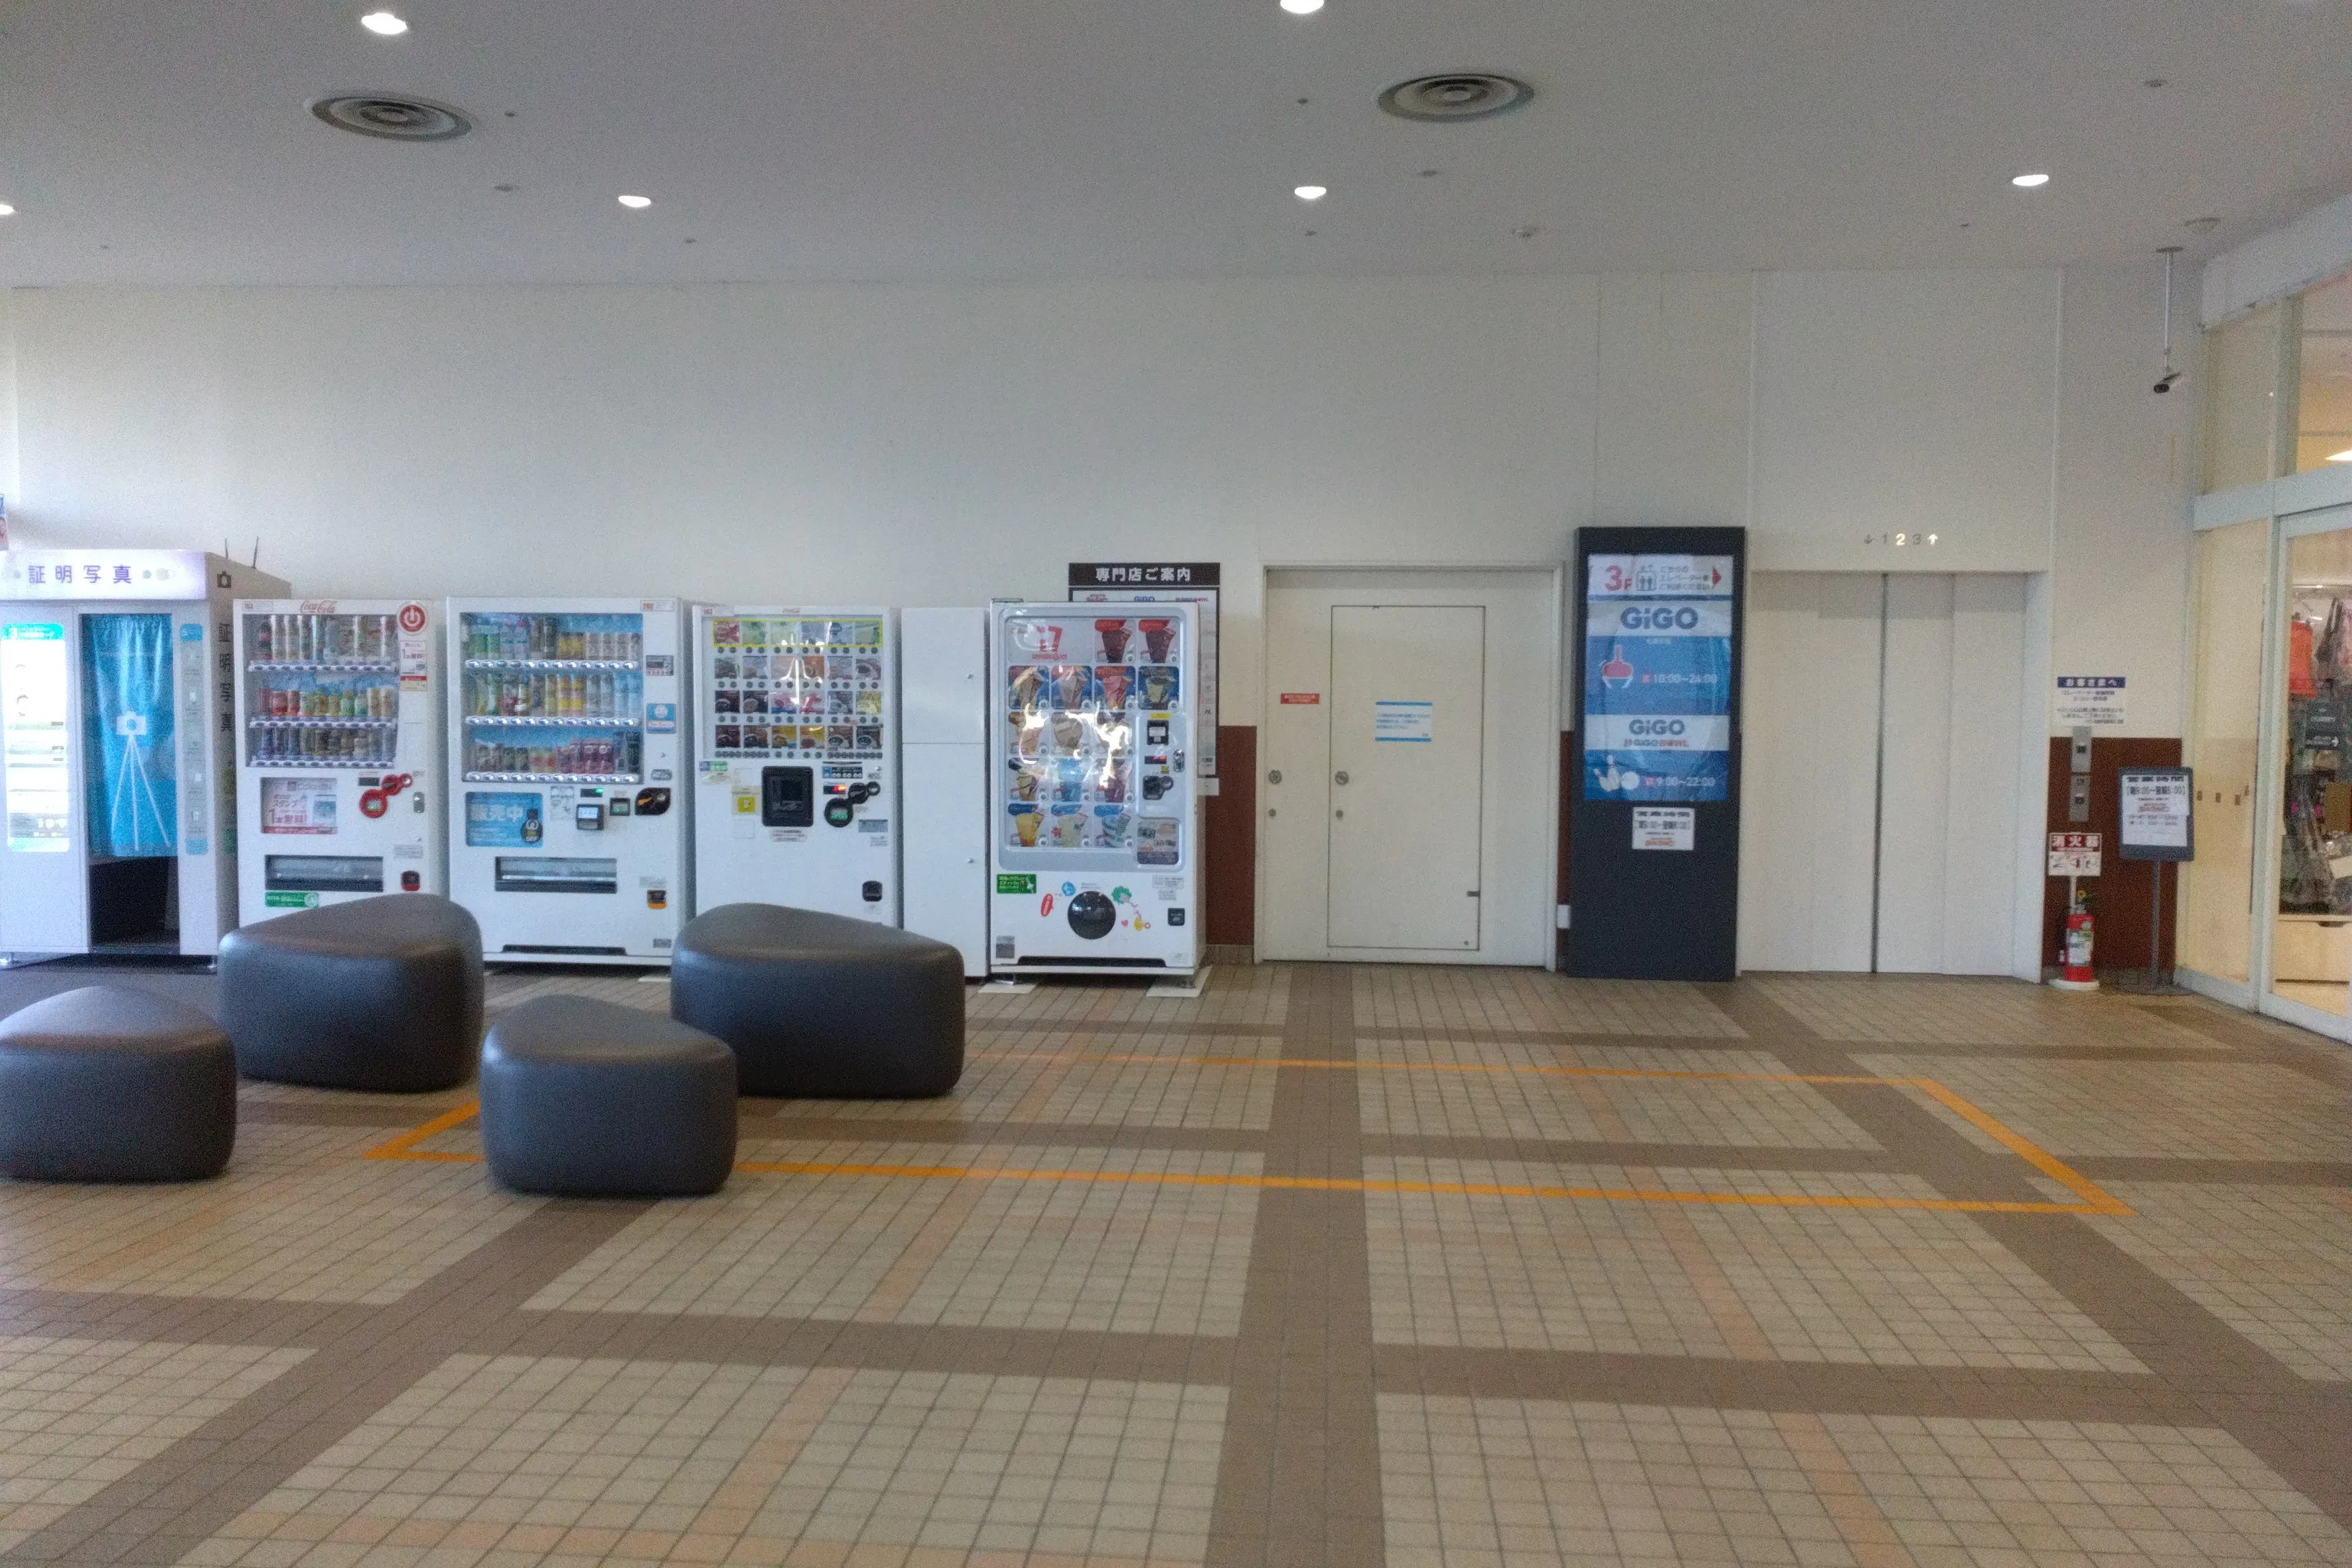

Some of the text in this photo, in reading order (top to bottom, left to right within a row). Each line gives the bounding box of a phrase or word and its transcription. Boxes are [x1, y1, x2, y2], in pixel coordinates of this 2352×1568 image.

[1896, 533, 1906, 545] 2
[28, 564, 132, 584] 証明写真
[1095, 567, 1191, 582] 専門店ご案内
[1621, 607, 1698, 629] GiGO
[1629, 719, 1686, 736] GiGO
